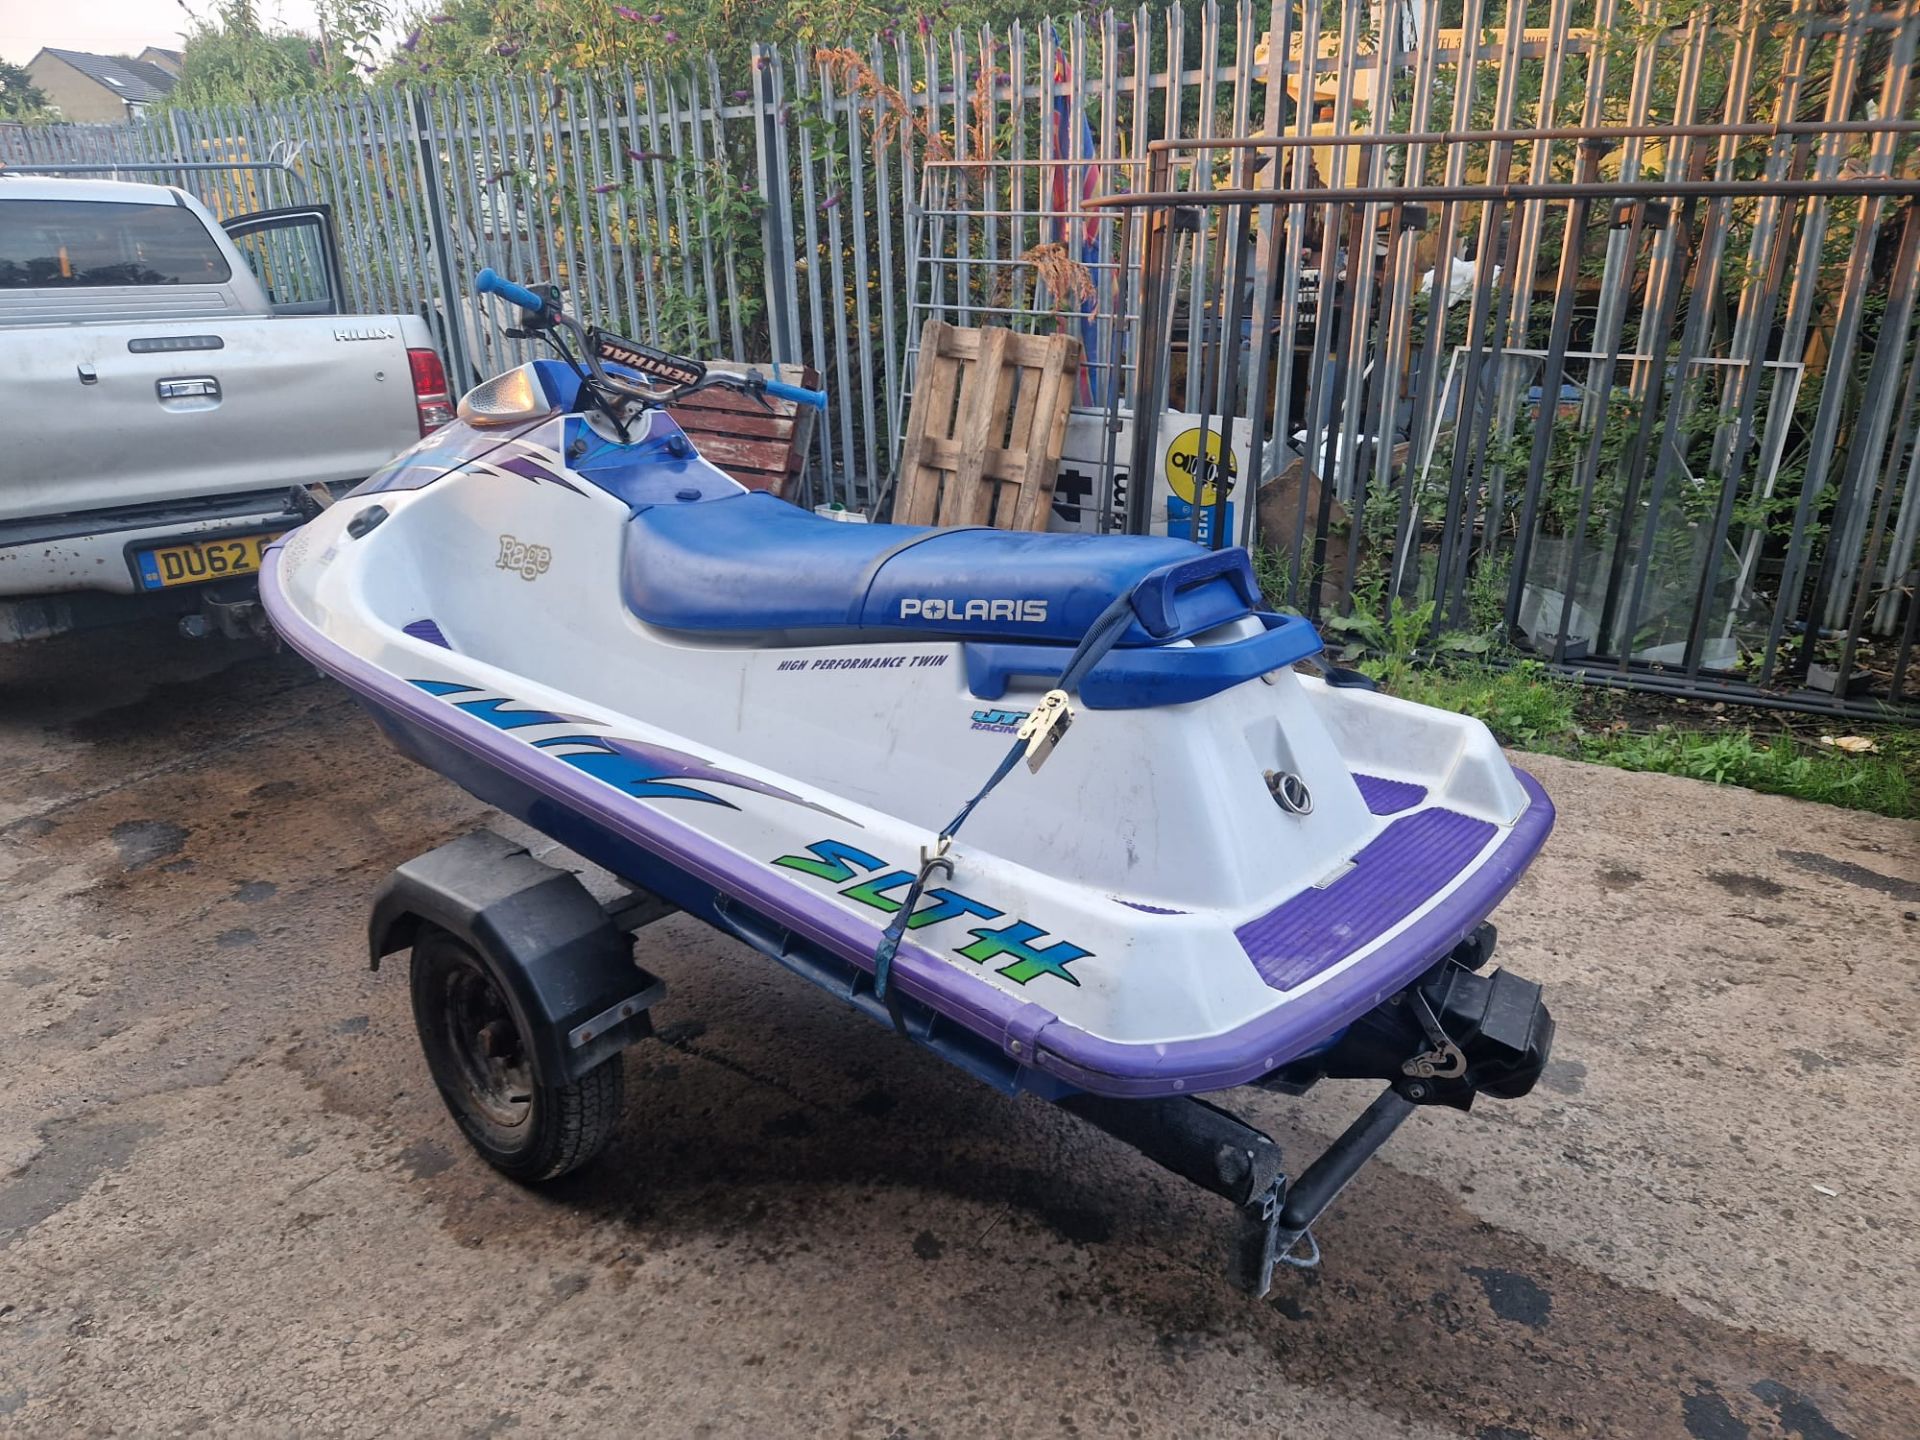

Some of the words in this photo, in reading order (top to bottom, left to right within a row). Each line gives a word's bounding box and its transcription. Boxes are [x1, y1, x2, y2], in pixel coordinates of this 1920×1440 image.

[334, 328, 395, 341] HILUX
[601, 344, 699, 385] RENTHAL
[161, 543, 250, 580] DU62
[496, 534, 552, 581] Rage
[900, 599, 1049, 622] POLARIS
[777, 660, 808, 671] HIGH
[811, 656, 906, 671] PERFORMANCE
[909, 654, 949, 667] TWIN
[971, 709, 1030, 726] JT
[770, 839, 1096, 986] SLTH
